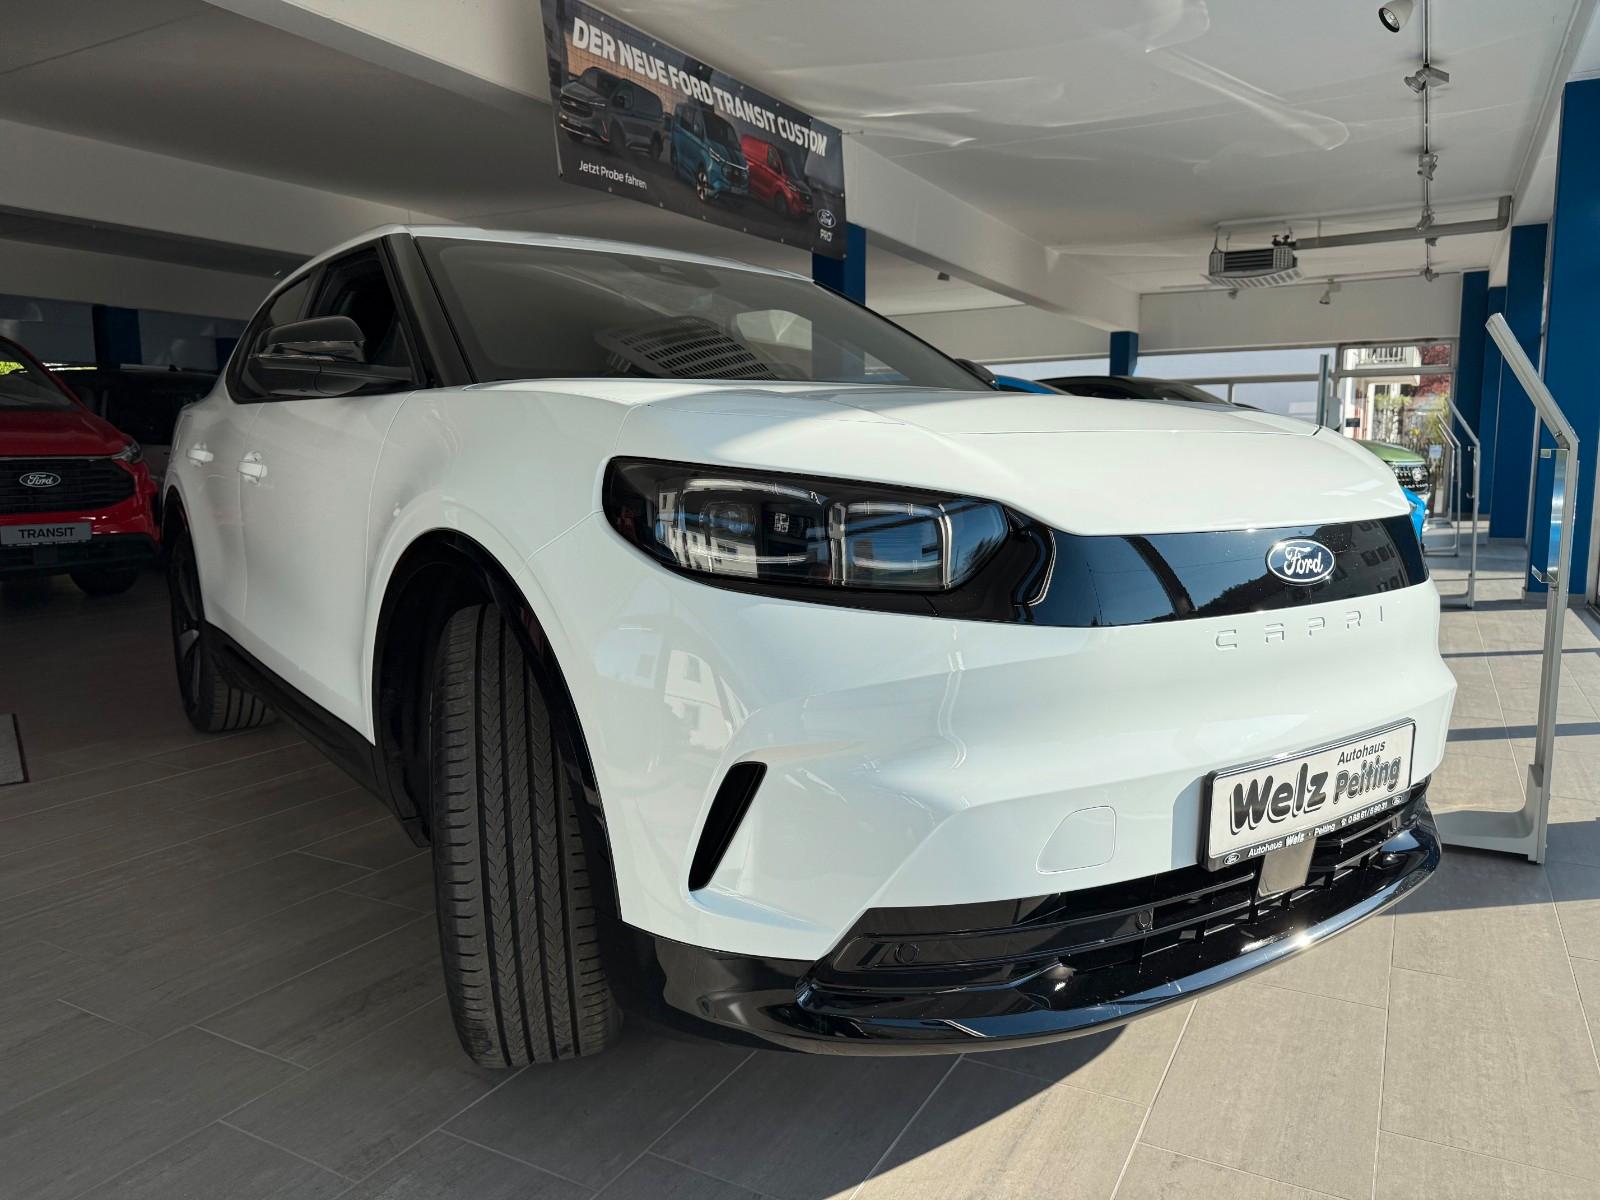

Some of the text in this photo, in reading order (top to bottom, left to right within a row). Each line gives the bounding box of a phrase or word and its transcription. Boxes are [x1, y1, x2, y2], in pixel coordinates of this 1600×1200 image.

[572, 16, 828, 157] DER NEUE FORD TRANSIT CUSTOM
[579, 160, 648, 190] Jetzt Probe fahren
[27, 474, 53, 486] Ford
[18, 527, 76, 539] TRANSIT
[1284, 546, 1324, 576] Ford
[1215, 605, 1384, 650] CAPRI
[1337, 740, 1386, 766] Autohaus
[1333, 755, 1401, 804] Peiting
[1229, 763, 1329, 835] Welz
[1247, 840, 1283, 858] Autohaus
[1285, 832, 1305, 847] Welz
[1313, 823, 1336, 837] Peiting
